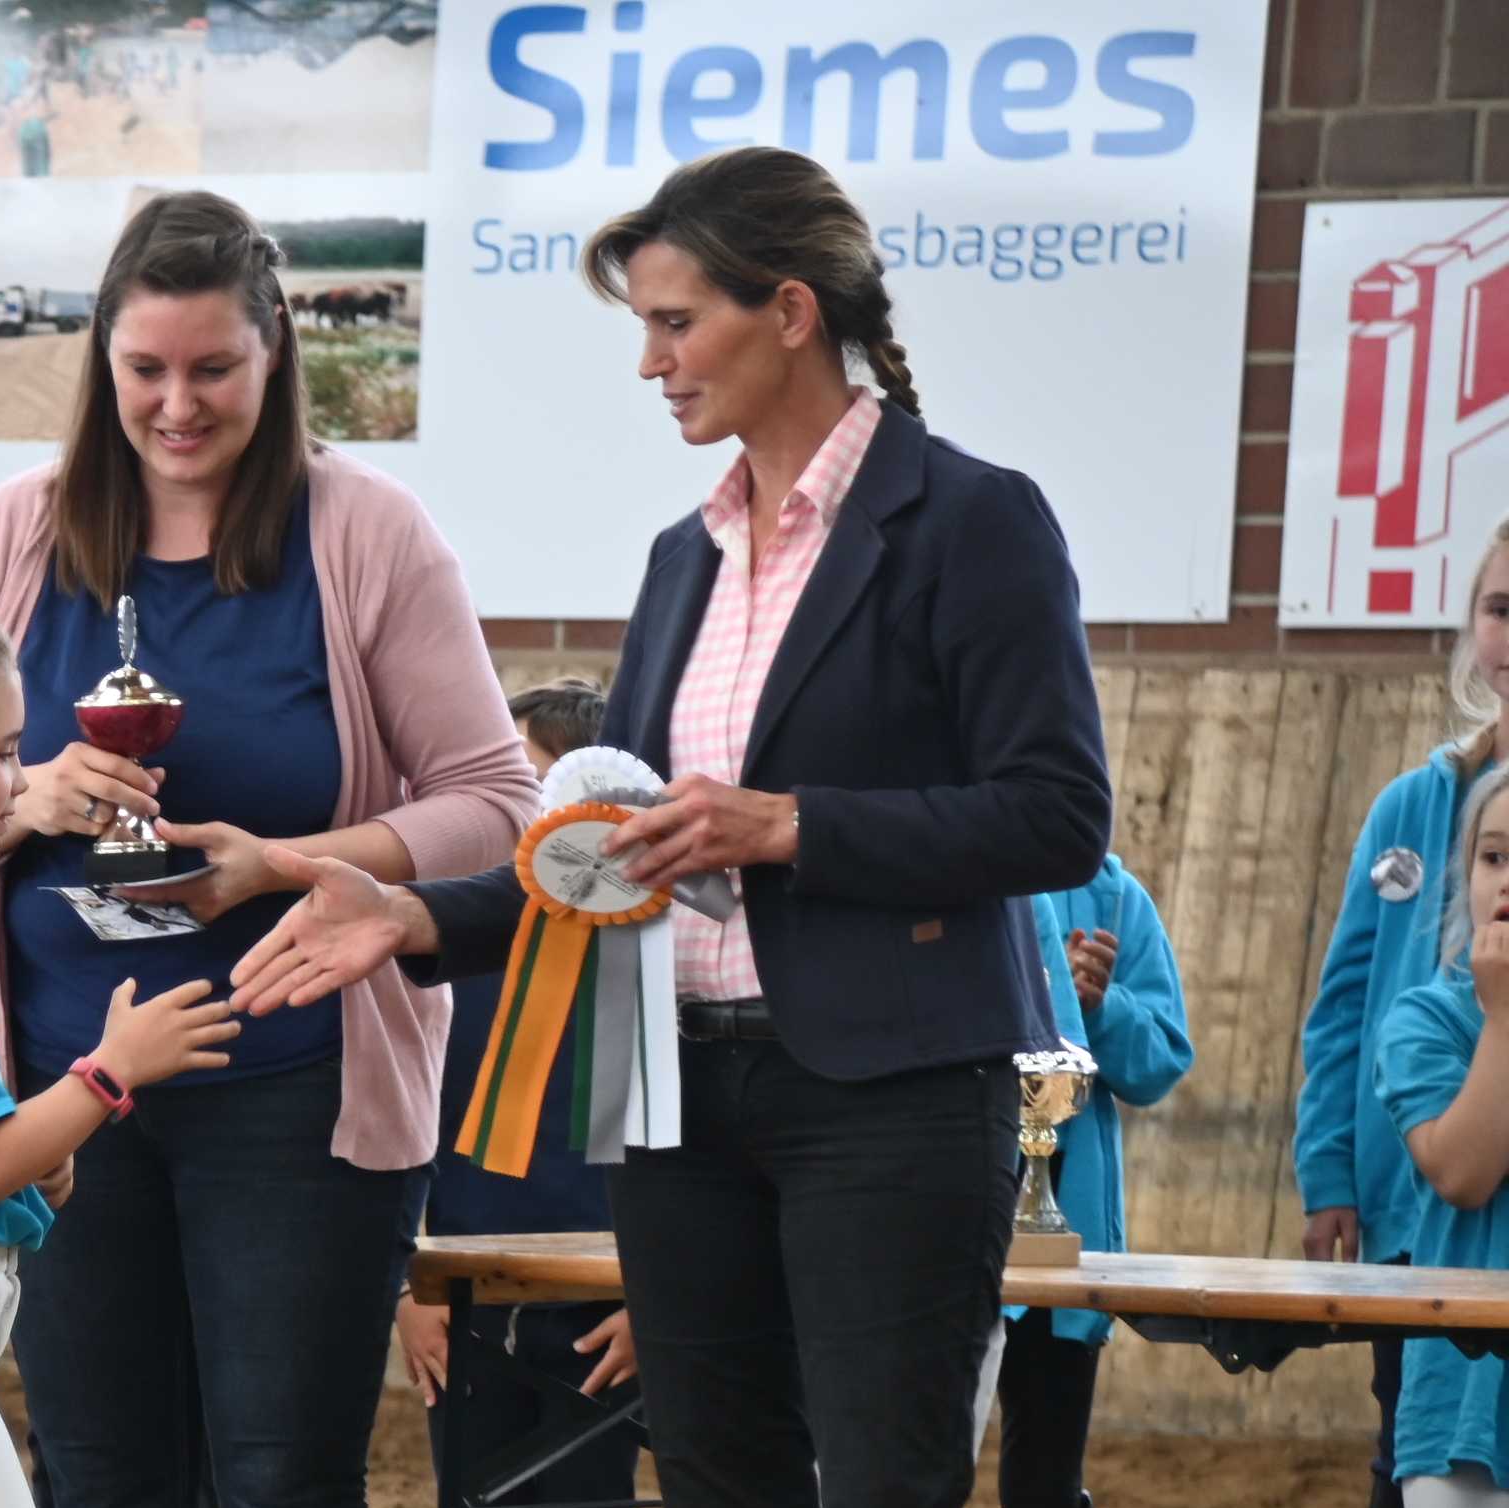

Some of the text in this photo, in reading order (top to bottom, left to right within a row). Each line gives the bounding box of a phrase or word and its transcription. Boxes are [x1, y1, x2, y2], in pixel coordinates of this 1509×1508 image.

[483, 0, 1199, 174] Siemes
[472, 208, 1188, 281] San sbaggerei
